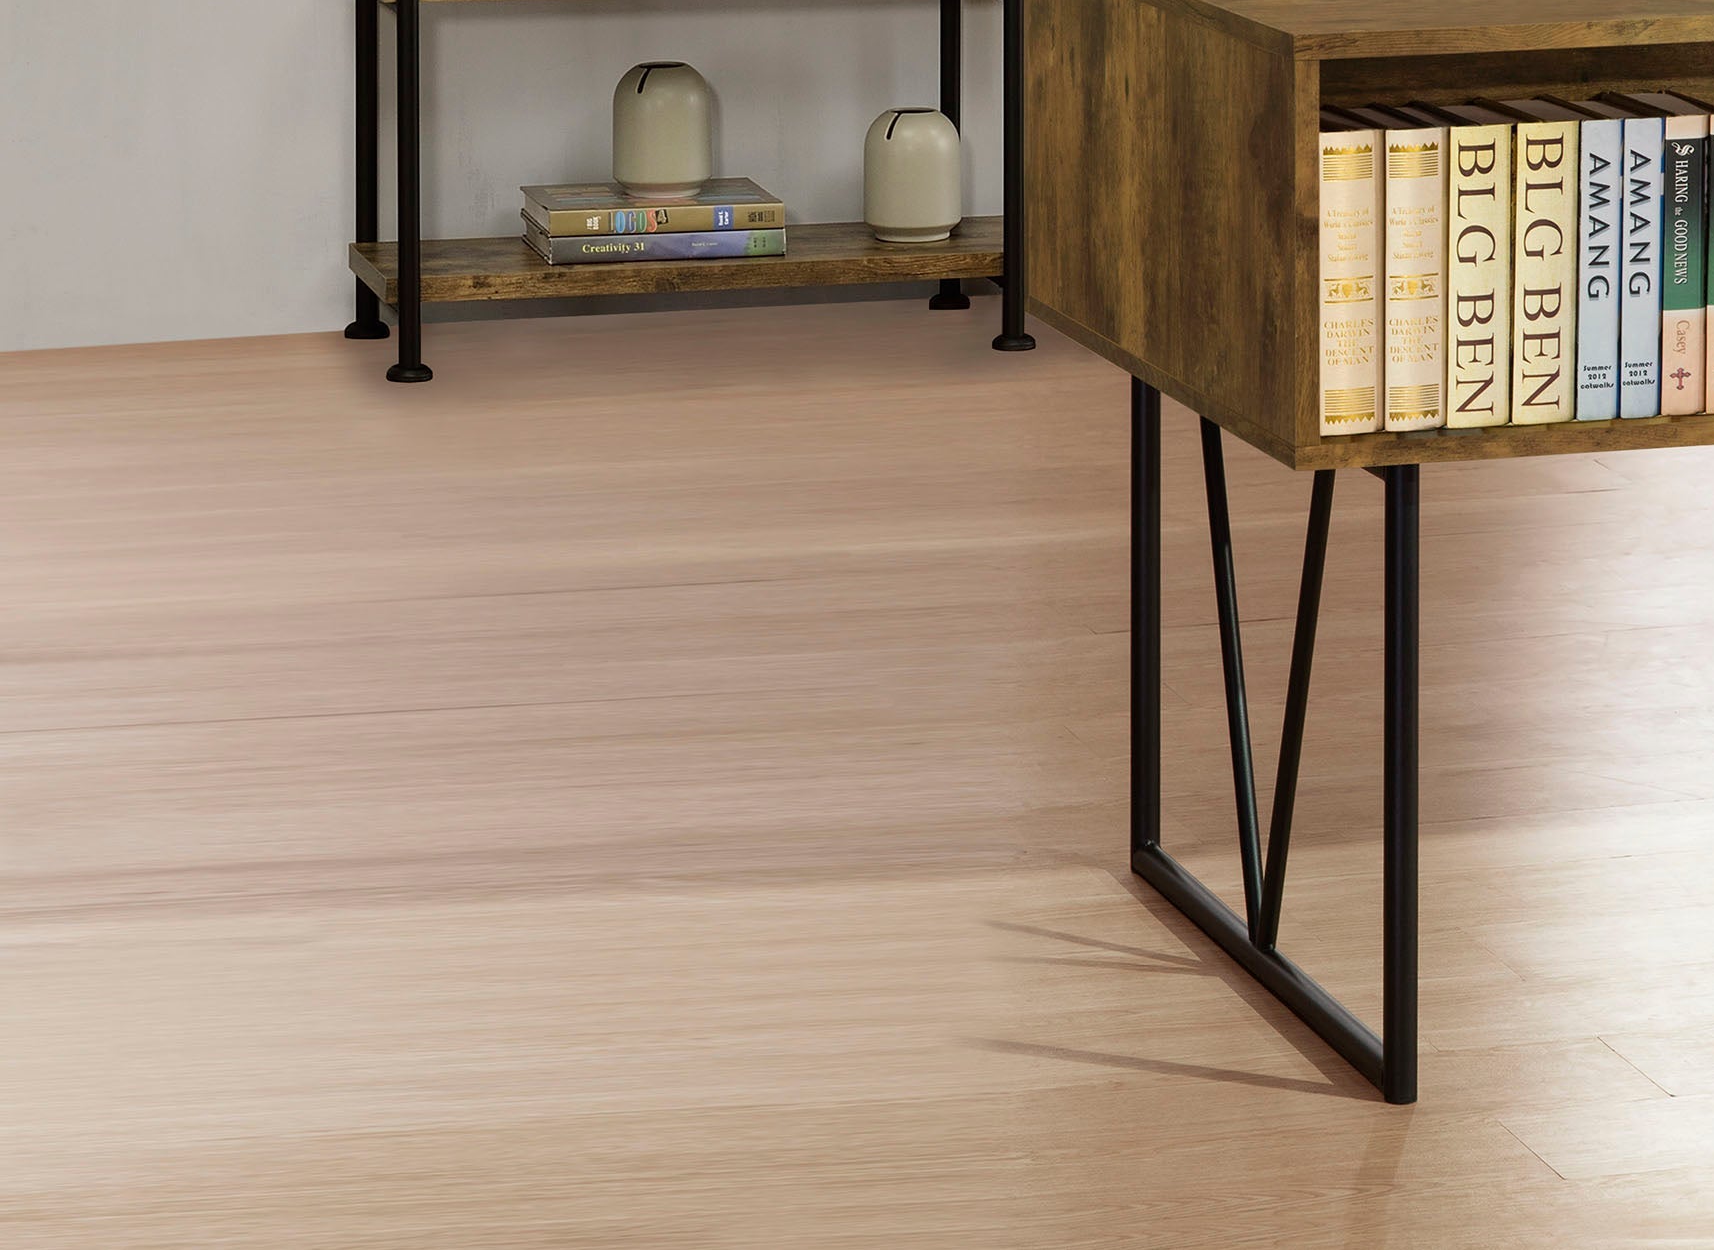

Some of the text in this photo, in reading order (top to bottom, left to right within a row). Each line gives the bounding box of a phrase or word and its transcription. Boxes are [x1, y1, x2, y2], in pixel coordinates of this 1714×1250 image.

[1674, 206, 1682, 216] the
[608, 208, 657, 234] LOGOS
[1587, 152, 1611, 301] AMANG
[1629, 149, 1652, 297] AMANG
[1674, 219, 1689, 257] GOOD
[582, 242, 645, 254] Creativity 31
[1455, 137, 1496, 416] BLG BEN
[1521, 131, 1564, 410] BLG BEN
[1674, 257, 1688, 285] NEWS
[1323, 318, 1374, 329] CHARLES
[1389, 315, 1439, 327] CHARLES
[1327, 328, 1370, 338] DARWIN
[1391, 325, 1435, 336] DARWIN
[1673, 320, 1690, 354] Casey
[1327, 356, 1369, 366] OF MAN
[1392, 353, 1433, 363] OF MAN
[1580, 382, 1614, 390] catwalks
